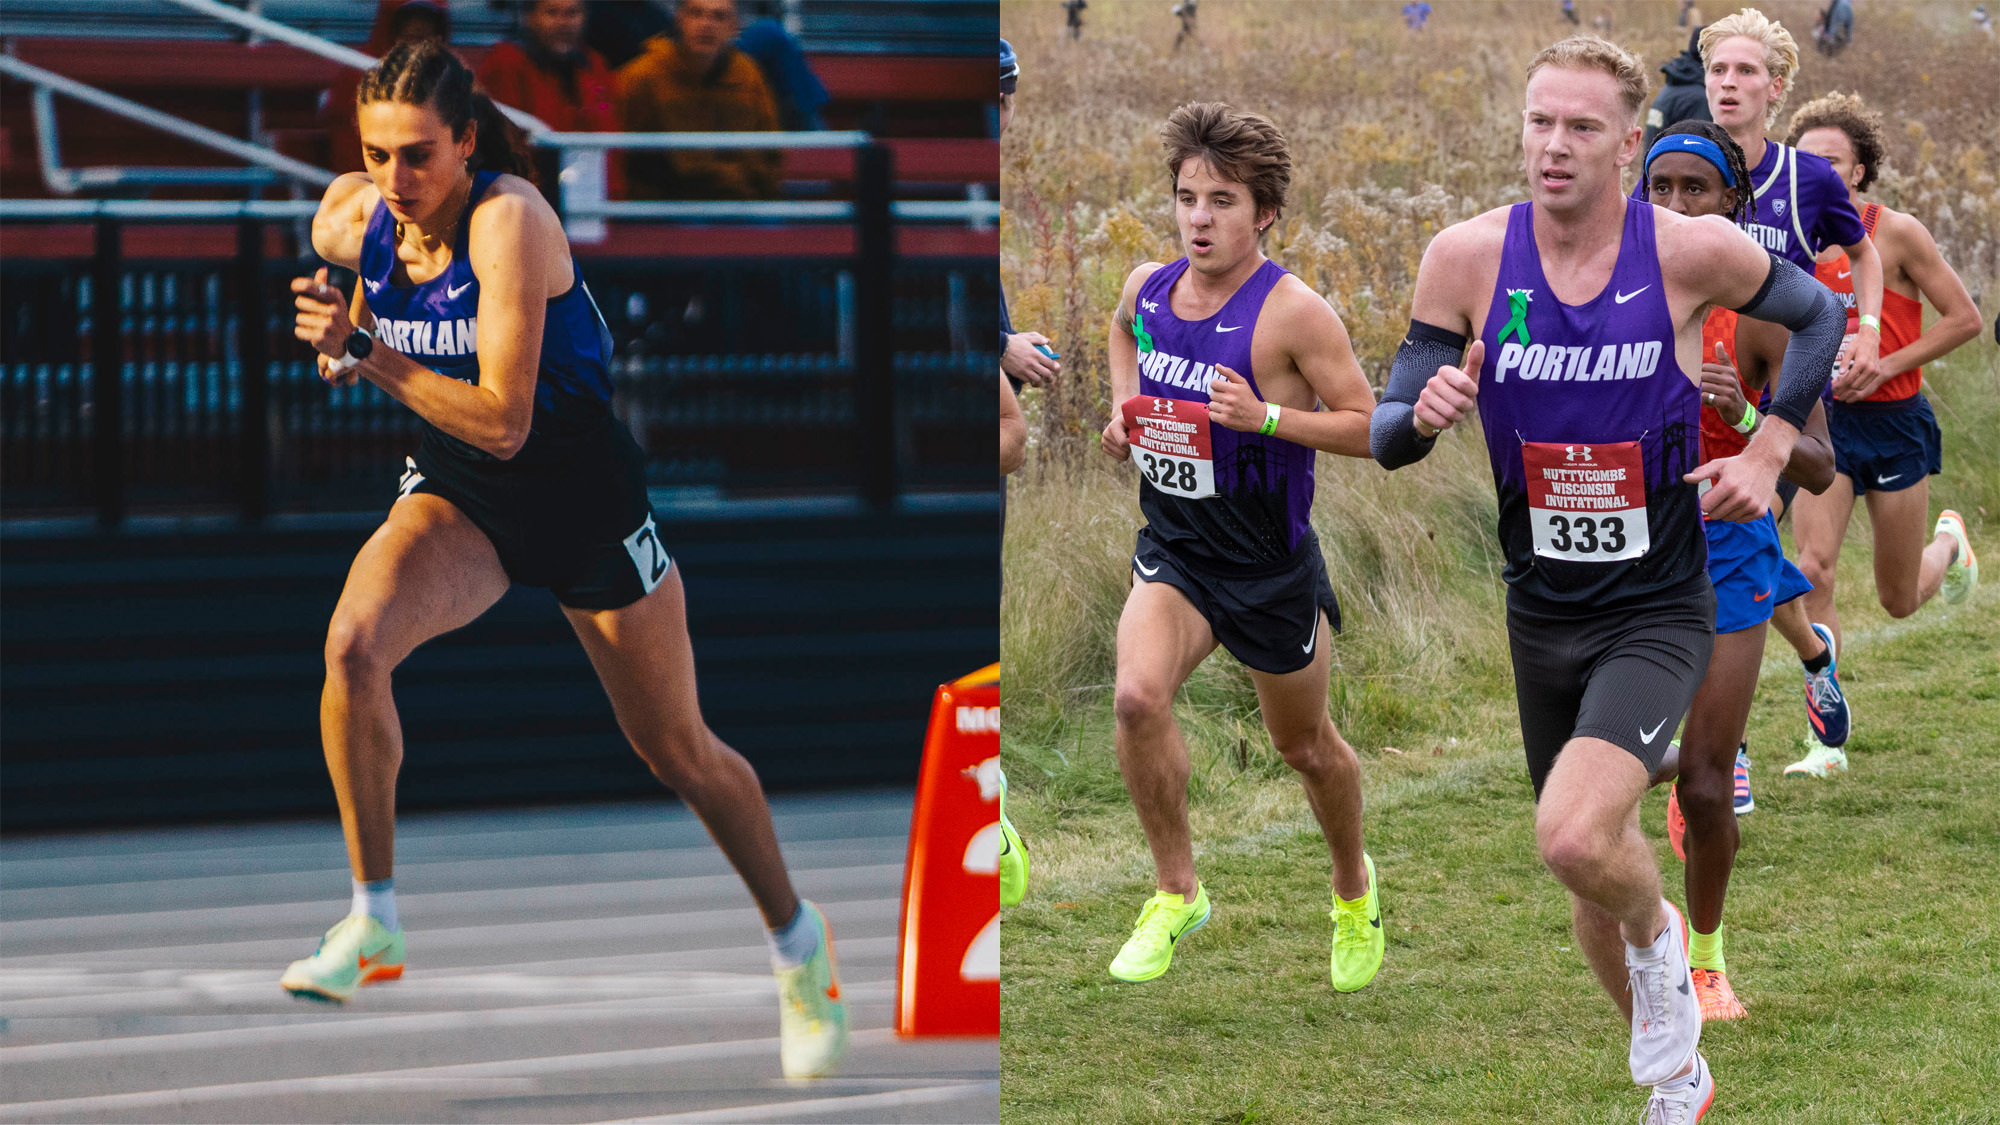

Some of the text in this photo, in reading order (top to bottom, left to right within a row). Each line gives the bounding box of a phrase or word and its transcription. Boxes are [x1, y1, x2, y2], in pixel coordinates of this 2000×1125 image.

[1736, 222, 1788, 253] GTON
[371, 311, 478, 356] ORTLAN
[1495, 340, 1663, 383] PORTLAND
[1135, 416, 1198, 434] NUTTYCOMBE
[1144, 426, 1190, 444] WISCONSIN
[1139, 435, 1200, 457] INVITATIONAL
[1143, 453, 1197, 492] 328
[1542, 467, 1627, 482] NUTTYCOMBE
[1551, 481, 1616, 495] WISCONSIN
[1545, 494, 1630, 509] INVITATIONAL
[1549, 515, 1627, 553] 333
